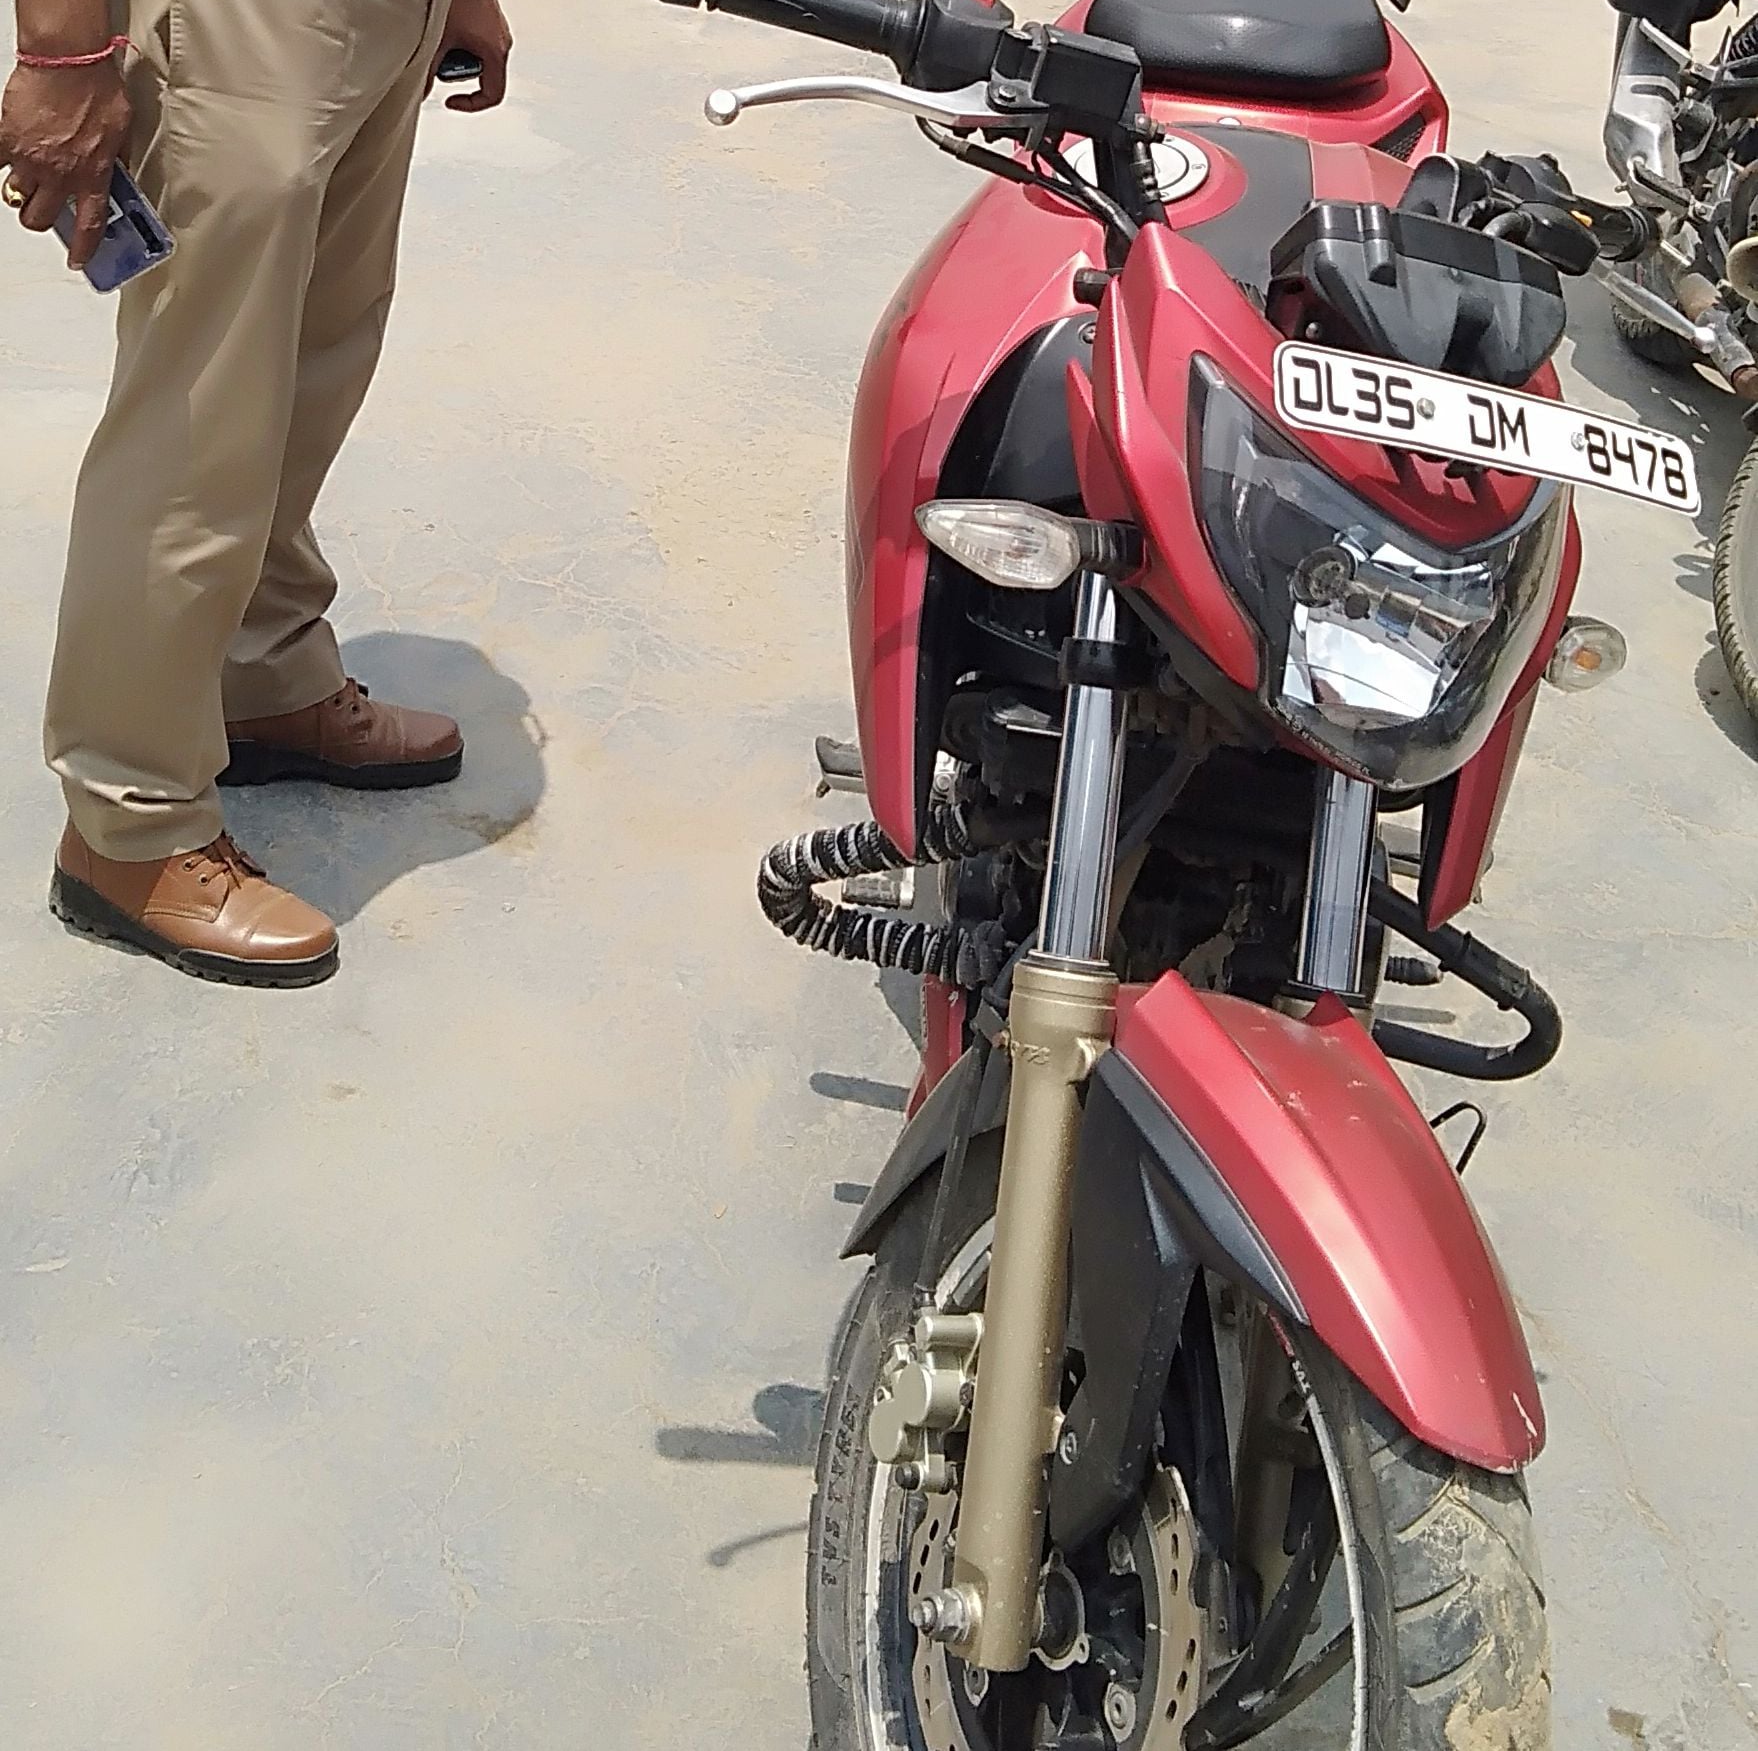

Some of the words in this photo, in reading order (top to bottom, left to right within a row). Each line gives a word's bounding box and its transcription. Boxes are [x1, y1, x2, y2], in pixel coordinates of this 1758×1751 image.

[1292, 355, 1415, 430] DL3S
[1467, 393, 1531, 457] DM
[1583, 423, 1688, 500] 8478
